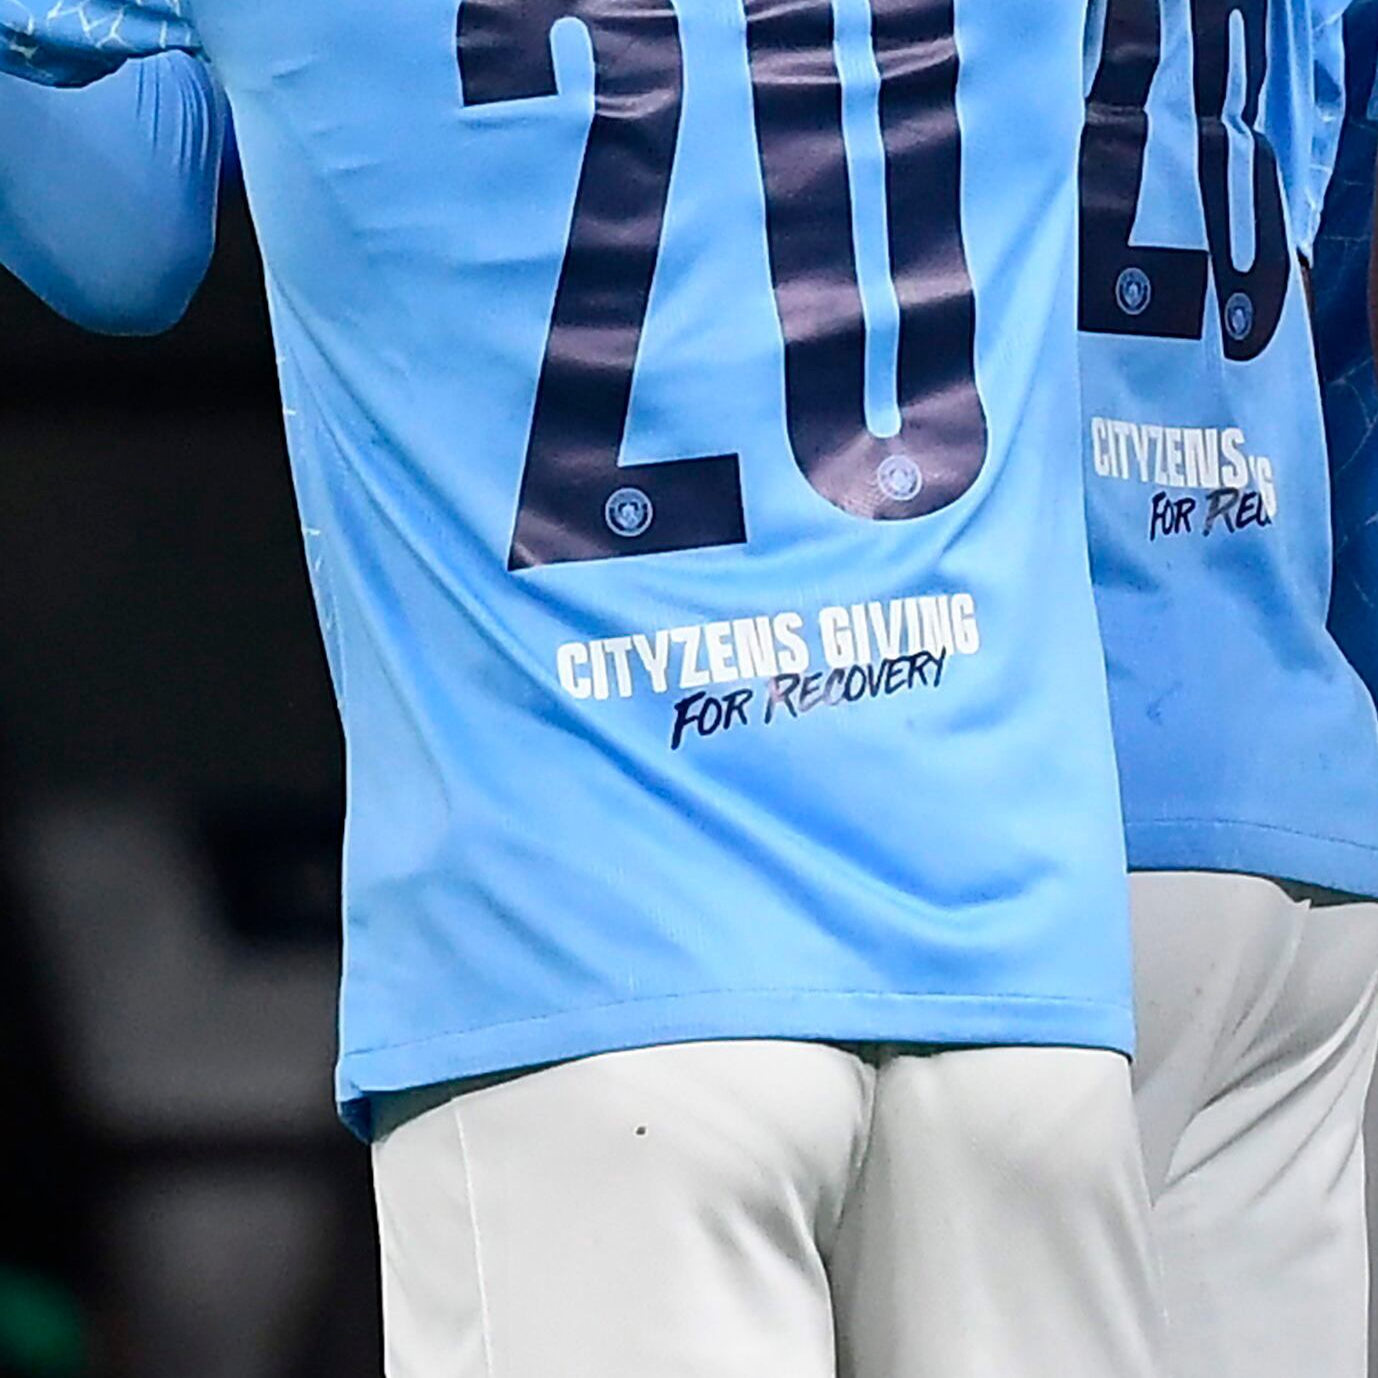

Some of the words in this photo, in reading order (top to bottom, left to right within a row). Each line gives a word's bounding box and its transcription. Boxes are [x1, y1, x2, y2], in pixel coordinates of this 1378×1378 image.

[1092, 417, 1249, 489] CITYZENS
[1150, 490, 1196, 541] FOR
[556, 612, 810, 701] CITYZENS
[818, 593, 980, 668] GIVING
[670, 689, 756, 751] FOR
[763, 646, 948, 725] RECOVERY
